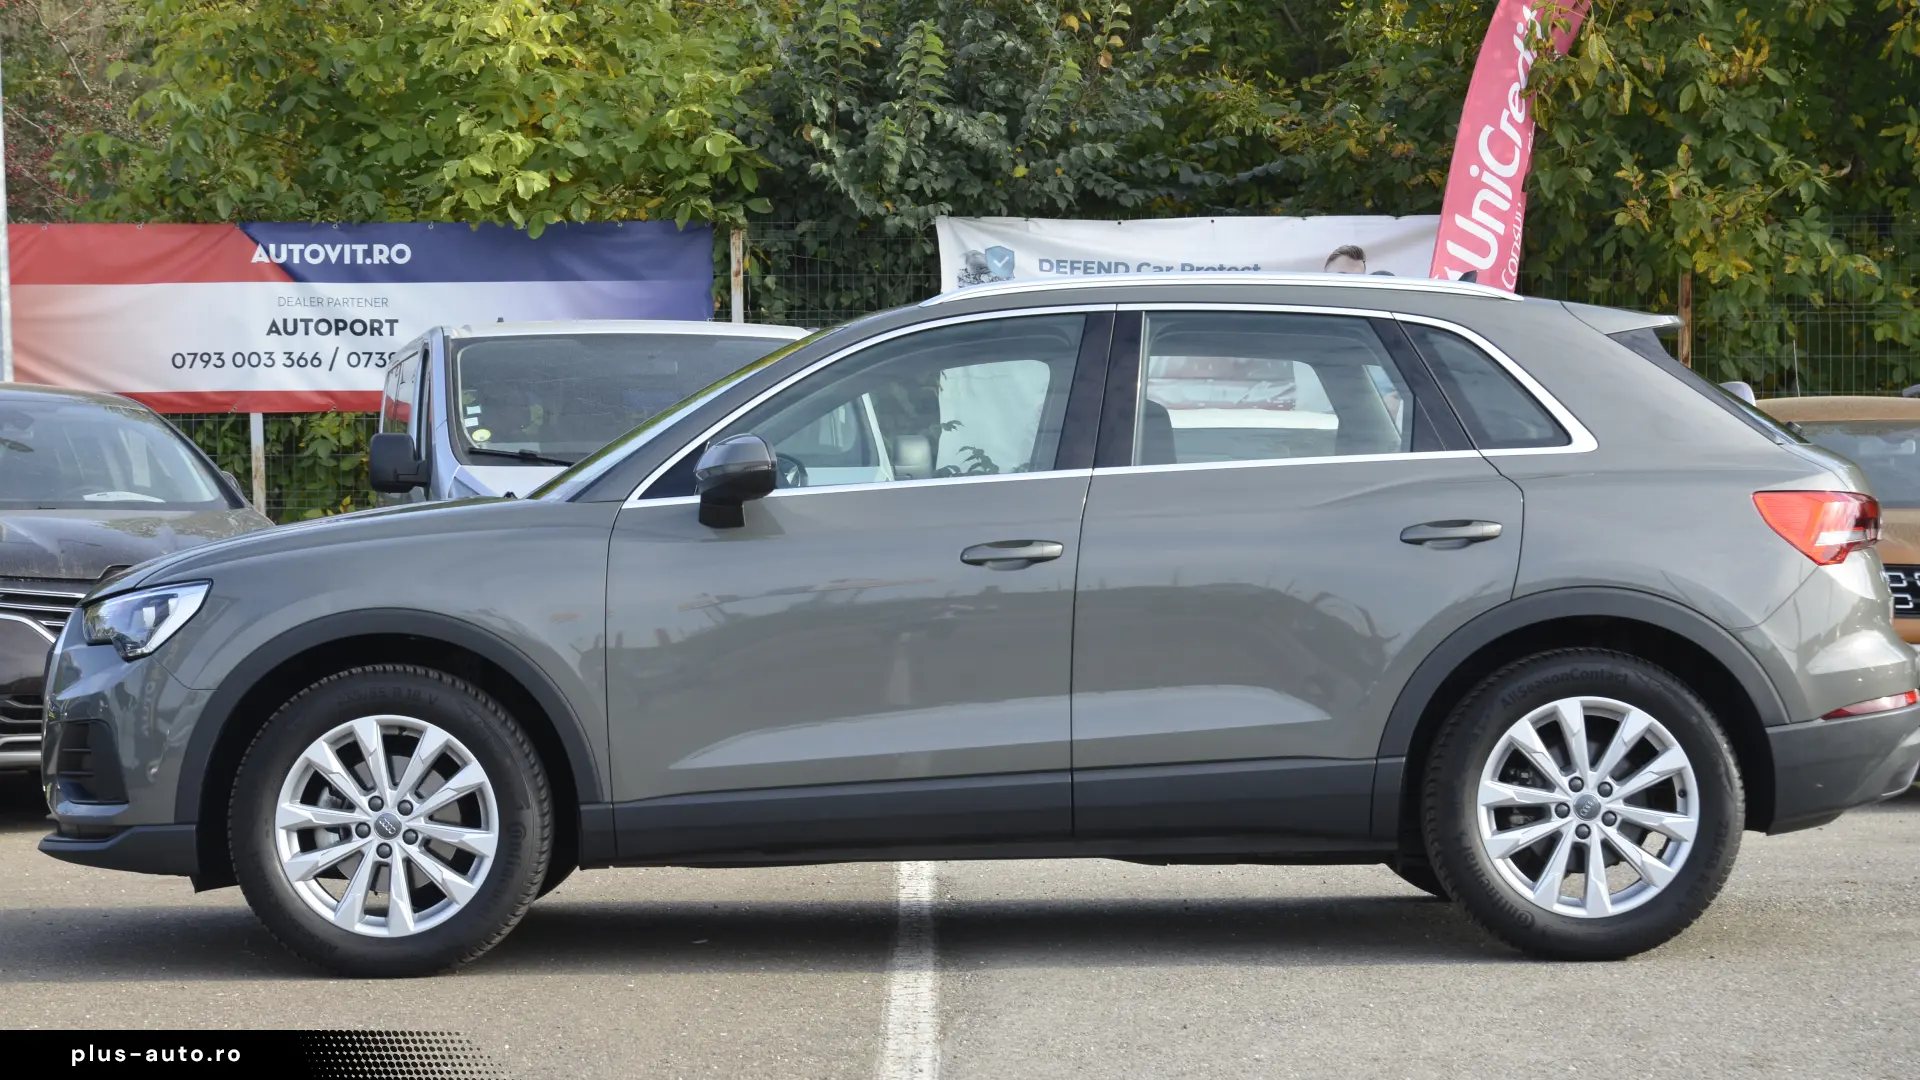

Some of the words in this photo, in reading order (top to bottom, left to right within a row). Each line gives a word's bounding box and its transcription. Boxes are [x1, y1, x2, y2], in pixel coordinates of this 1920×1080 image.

[251, 243, 412, 265] AUTOVIT.RO
[1038, 258, 1130, 275] DEFEND
[1136, 262, 1174, 273] Car
[278, 296, 324, 307] DEALER
[327, 297, 389, 308] PARTENER
[266, 317, 399, 337] AUTOPORT
[171, 352, 226, 369] 0793
[232, 351, 276, 368] 003
[282, 351, 323, 368] 366
[328, 346, 340, 372] /
